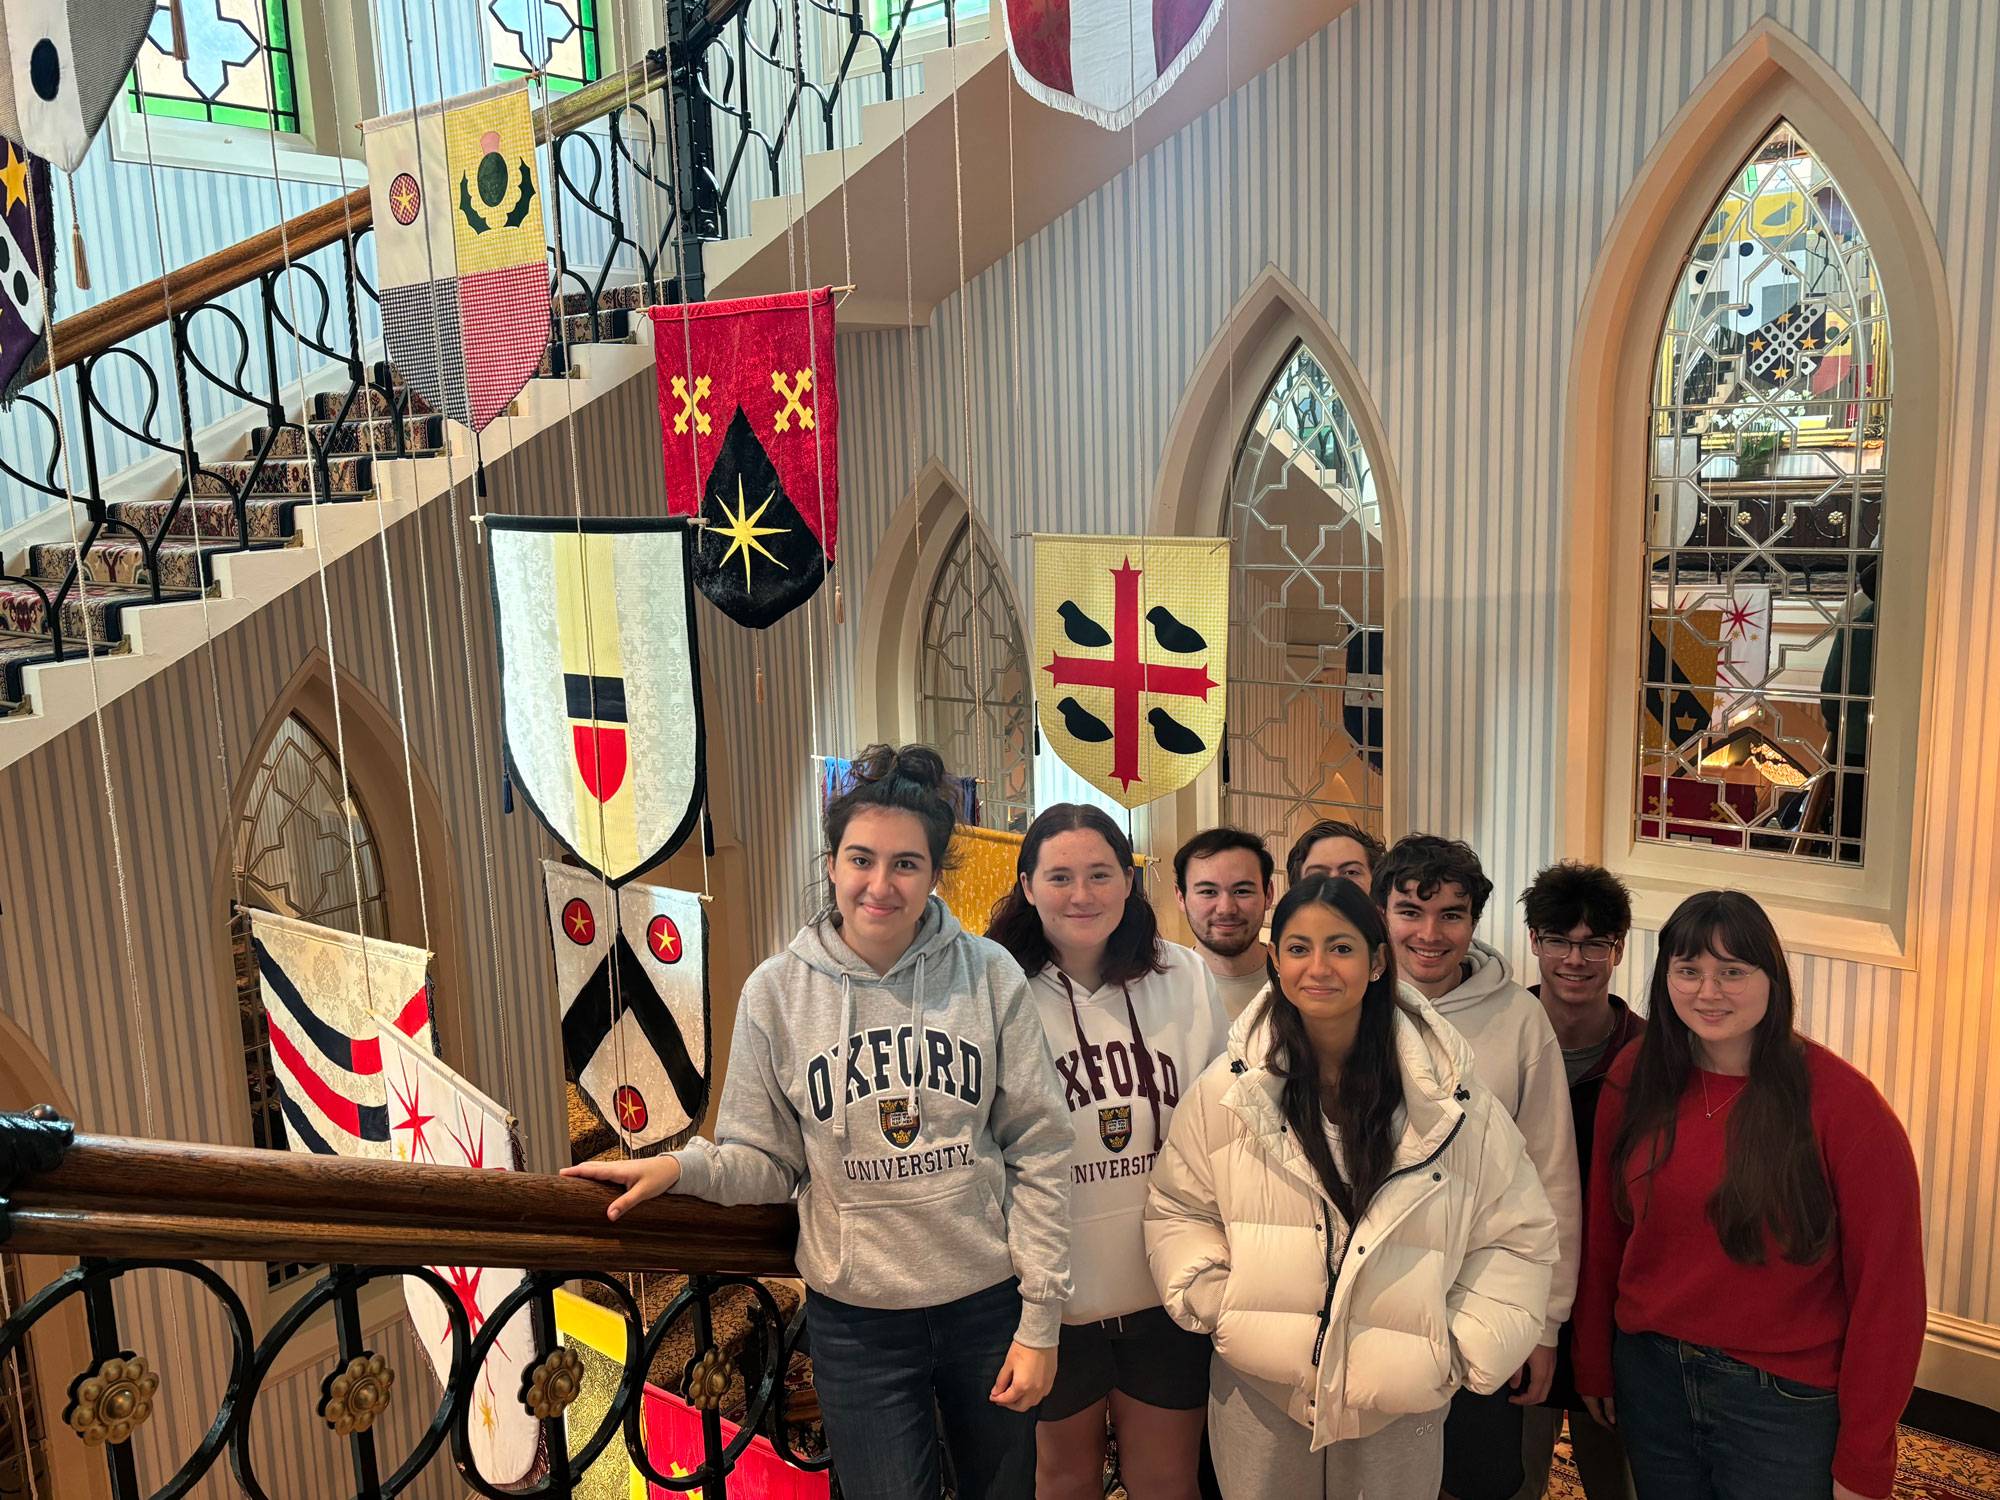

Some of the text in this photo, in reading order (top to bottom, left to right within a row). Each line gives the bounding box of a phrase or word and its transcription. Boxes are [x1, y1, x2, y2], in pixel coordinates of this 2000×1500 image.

[807, 1025, 982, 1123] OXFORD
[1055, 1041, 1180, 1112] XFORD
[1070, 1152, 1160, 1184] NIVERSIT
